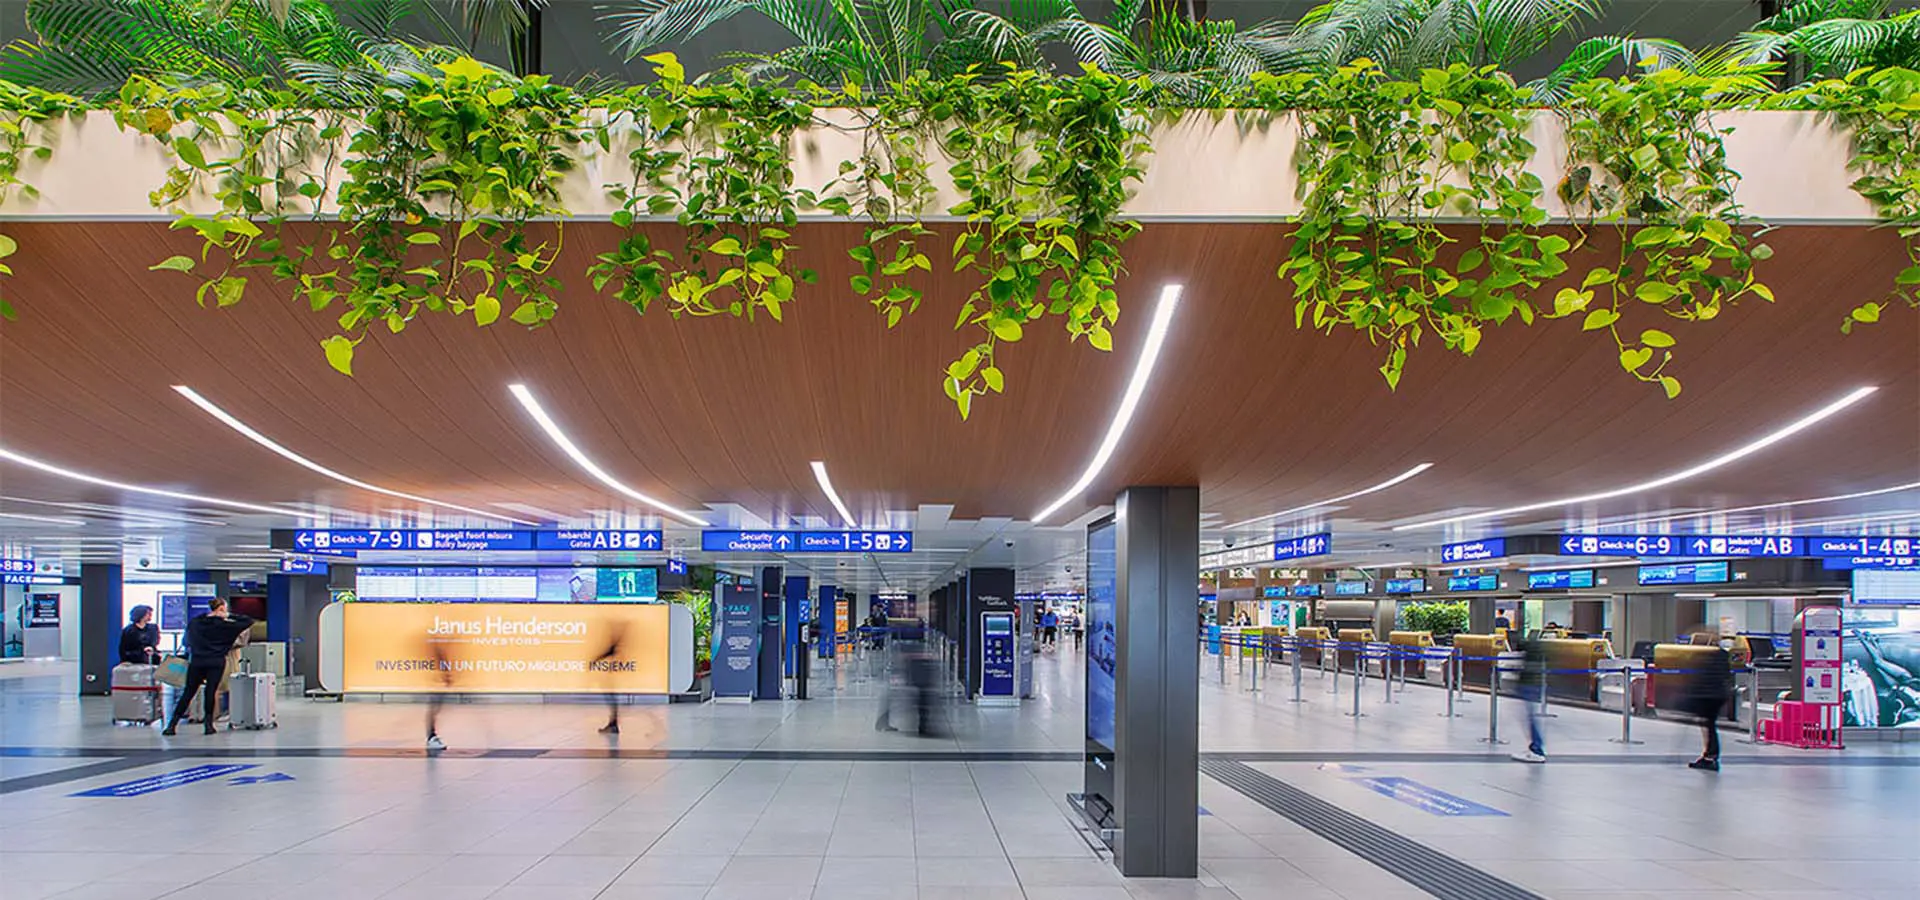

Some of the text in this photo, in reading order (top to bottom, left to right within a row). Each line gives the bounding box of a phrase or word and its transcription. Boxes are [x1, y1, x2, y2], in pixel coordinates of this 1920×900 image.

[331, 531, 403, 548] Check-in 7-9
[435, 531, 513, 541] Bagagli fuori misura
[557, 531, 592, 539] Imbarchi
[740, 533, 773, 542] Security
[435, 539, 489, 549] Bulky baggage
[569, 540, 592, 548] Gates
[728, 541, 773, 550] Checkpoint
[804, 533, 873, 550] Check-in 1-5
[1599, 537, 1671, 554] Check-in 6-9
[1727, 537, 1763, 546] Imbarchi
[1762, 537, 1793, 555] AB
[1822, 538, 1893, 555] Check-in 1-4
[1727, 546, 1751, 554] Gates
[427, 616, 587, 636] Janus Henderson
[472, 638, 541, 646] INVESTORS
[375, 660, 636, 672] INVESTIRE IN UN FUTURO MIGLIORE INSIEME
